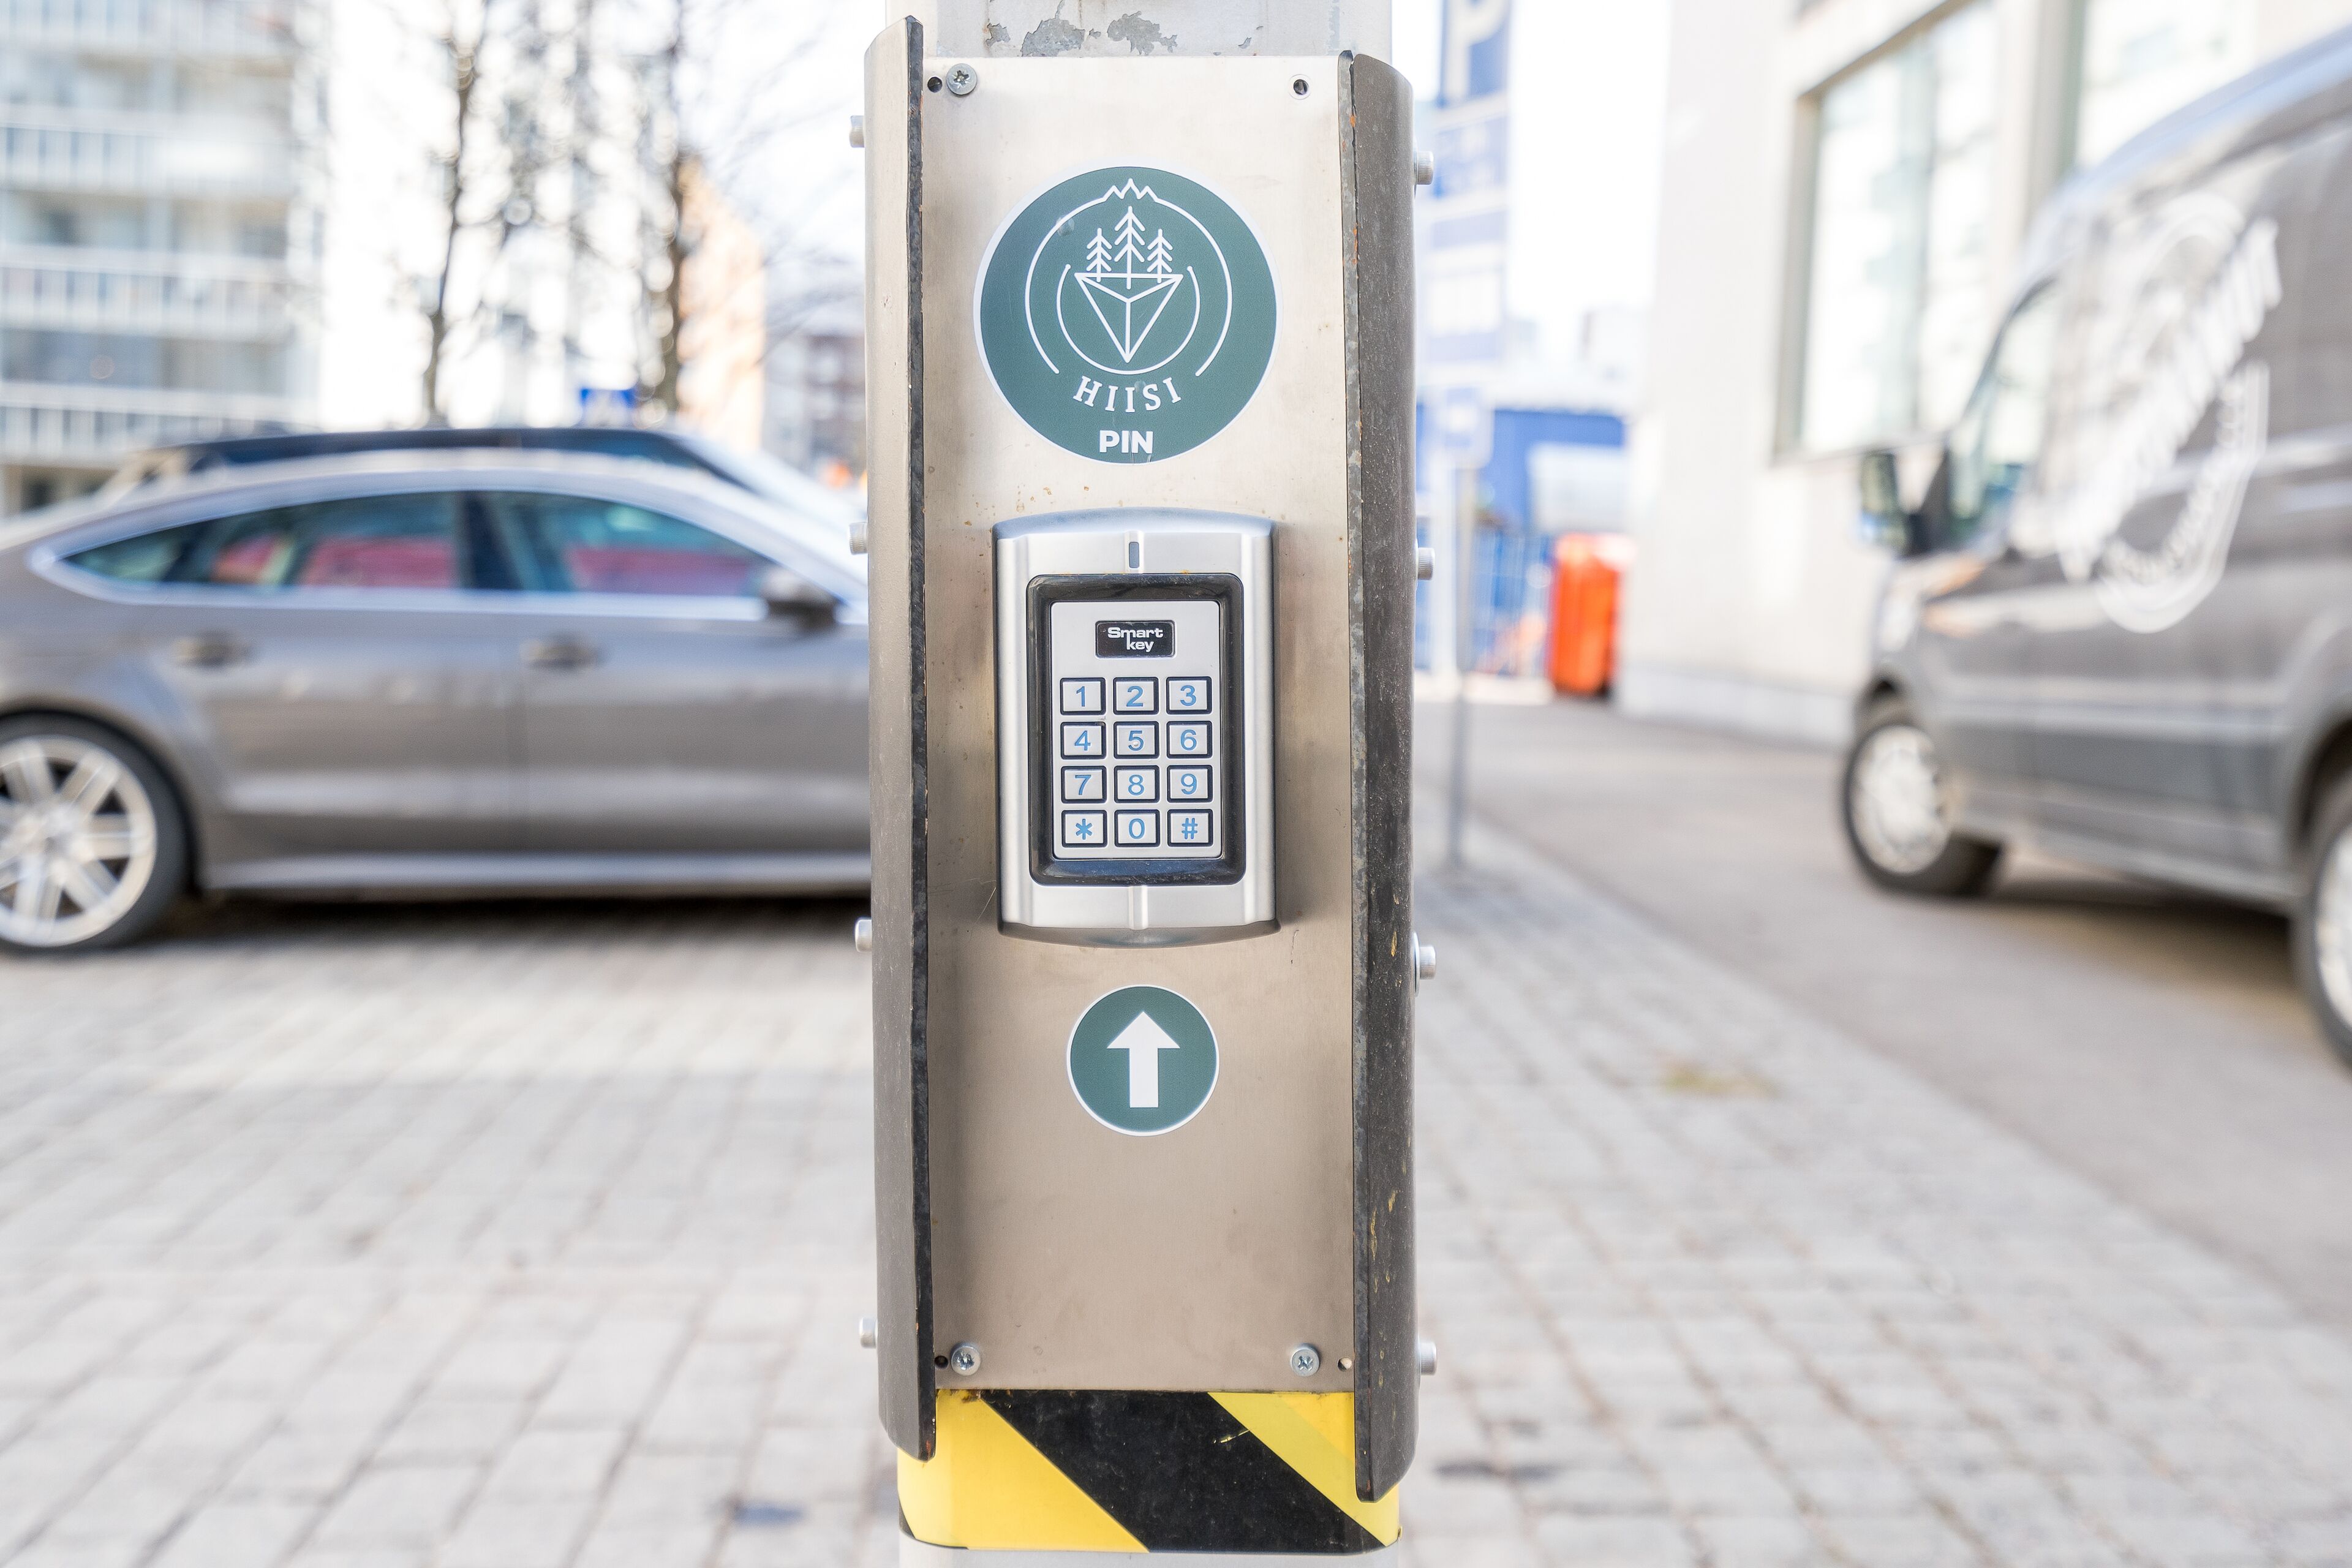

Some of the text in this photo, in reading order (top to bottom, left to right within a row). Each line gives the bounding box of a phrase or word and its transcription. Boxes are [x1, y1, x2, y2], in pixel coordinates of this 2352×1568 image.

[1072, 375, 1182, 413] HIISI
[1099, 430, 1153, 454] PIN
[1107, 627, 1164, 638] Smart
[1126, 636, 1155, 653] key
[1076, 685, 1197, 707] 1 2 3
[1074, 729, 1197, 751] 4 5 6
[1074, 774, 1197, 796] 7 8 9
[1128, 818, 1145, 840] 0
[1181, 818, 1198, 840] #
